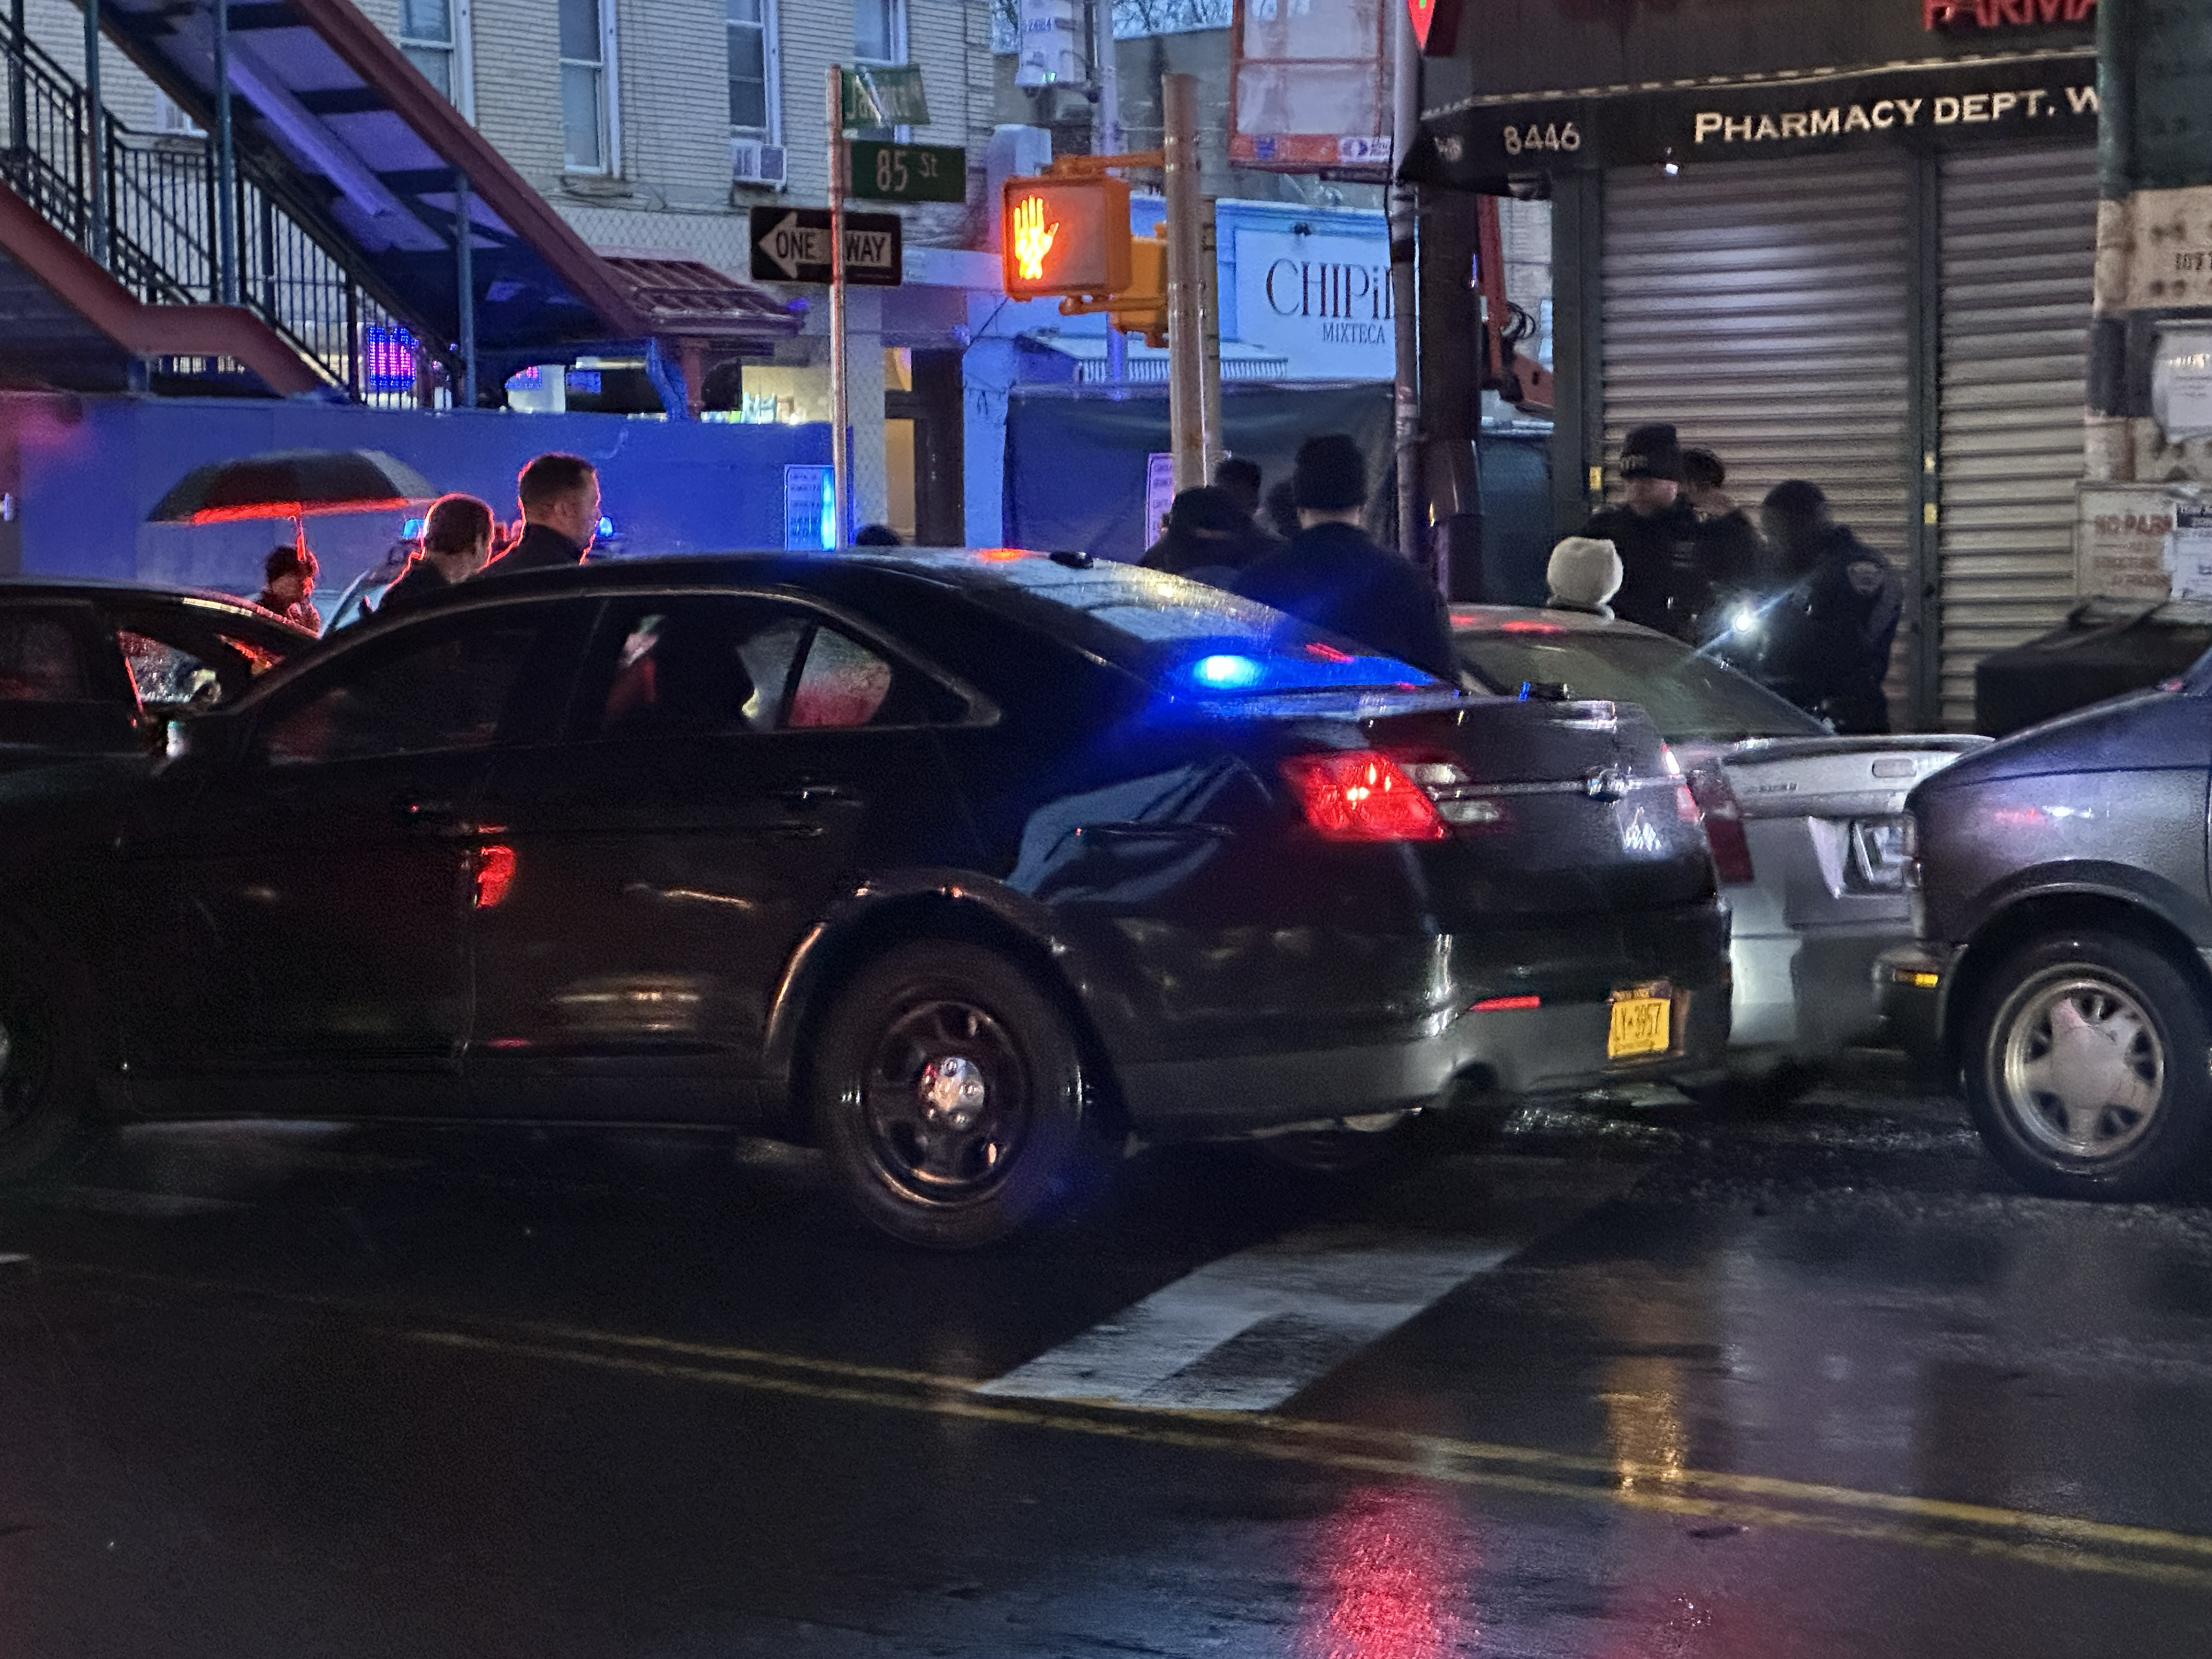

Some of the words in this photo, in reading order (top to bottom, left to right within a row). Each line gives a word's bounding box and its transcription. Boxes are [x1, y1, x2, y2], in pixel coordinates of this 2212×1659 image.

[1694, 98, 1922, 143] PHARMACY
[1933, 88, 2055, 125] DEPT.
[1504, 121, 1581, 156] 8446
[876, 149, 909, 192] 85
[775, 229, 817, 261] ONE
[842, 233, 886, 264] WAY
[1323, 321, 1386, 344] MIXTECA
